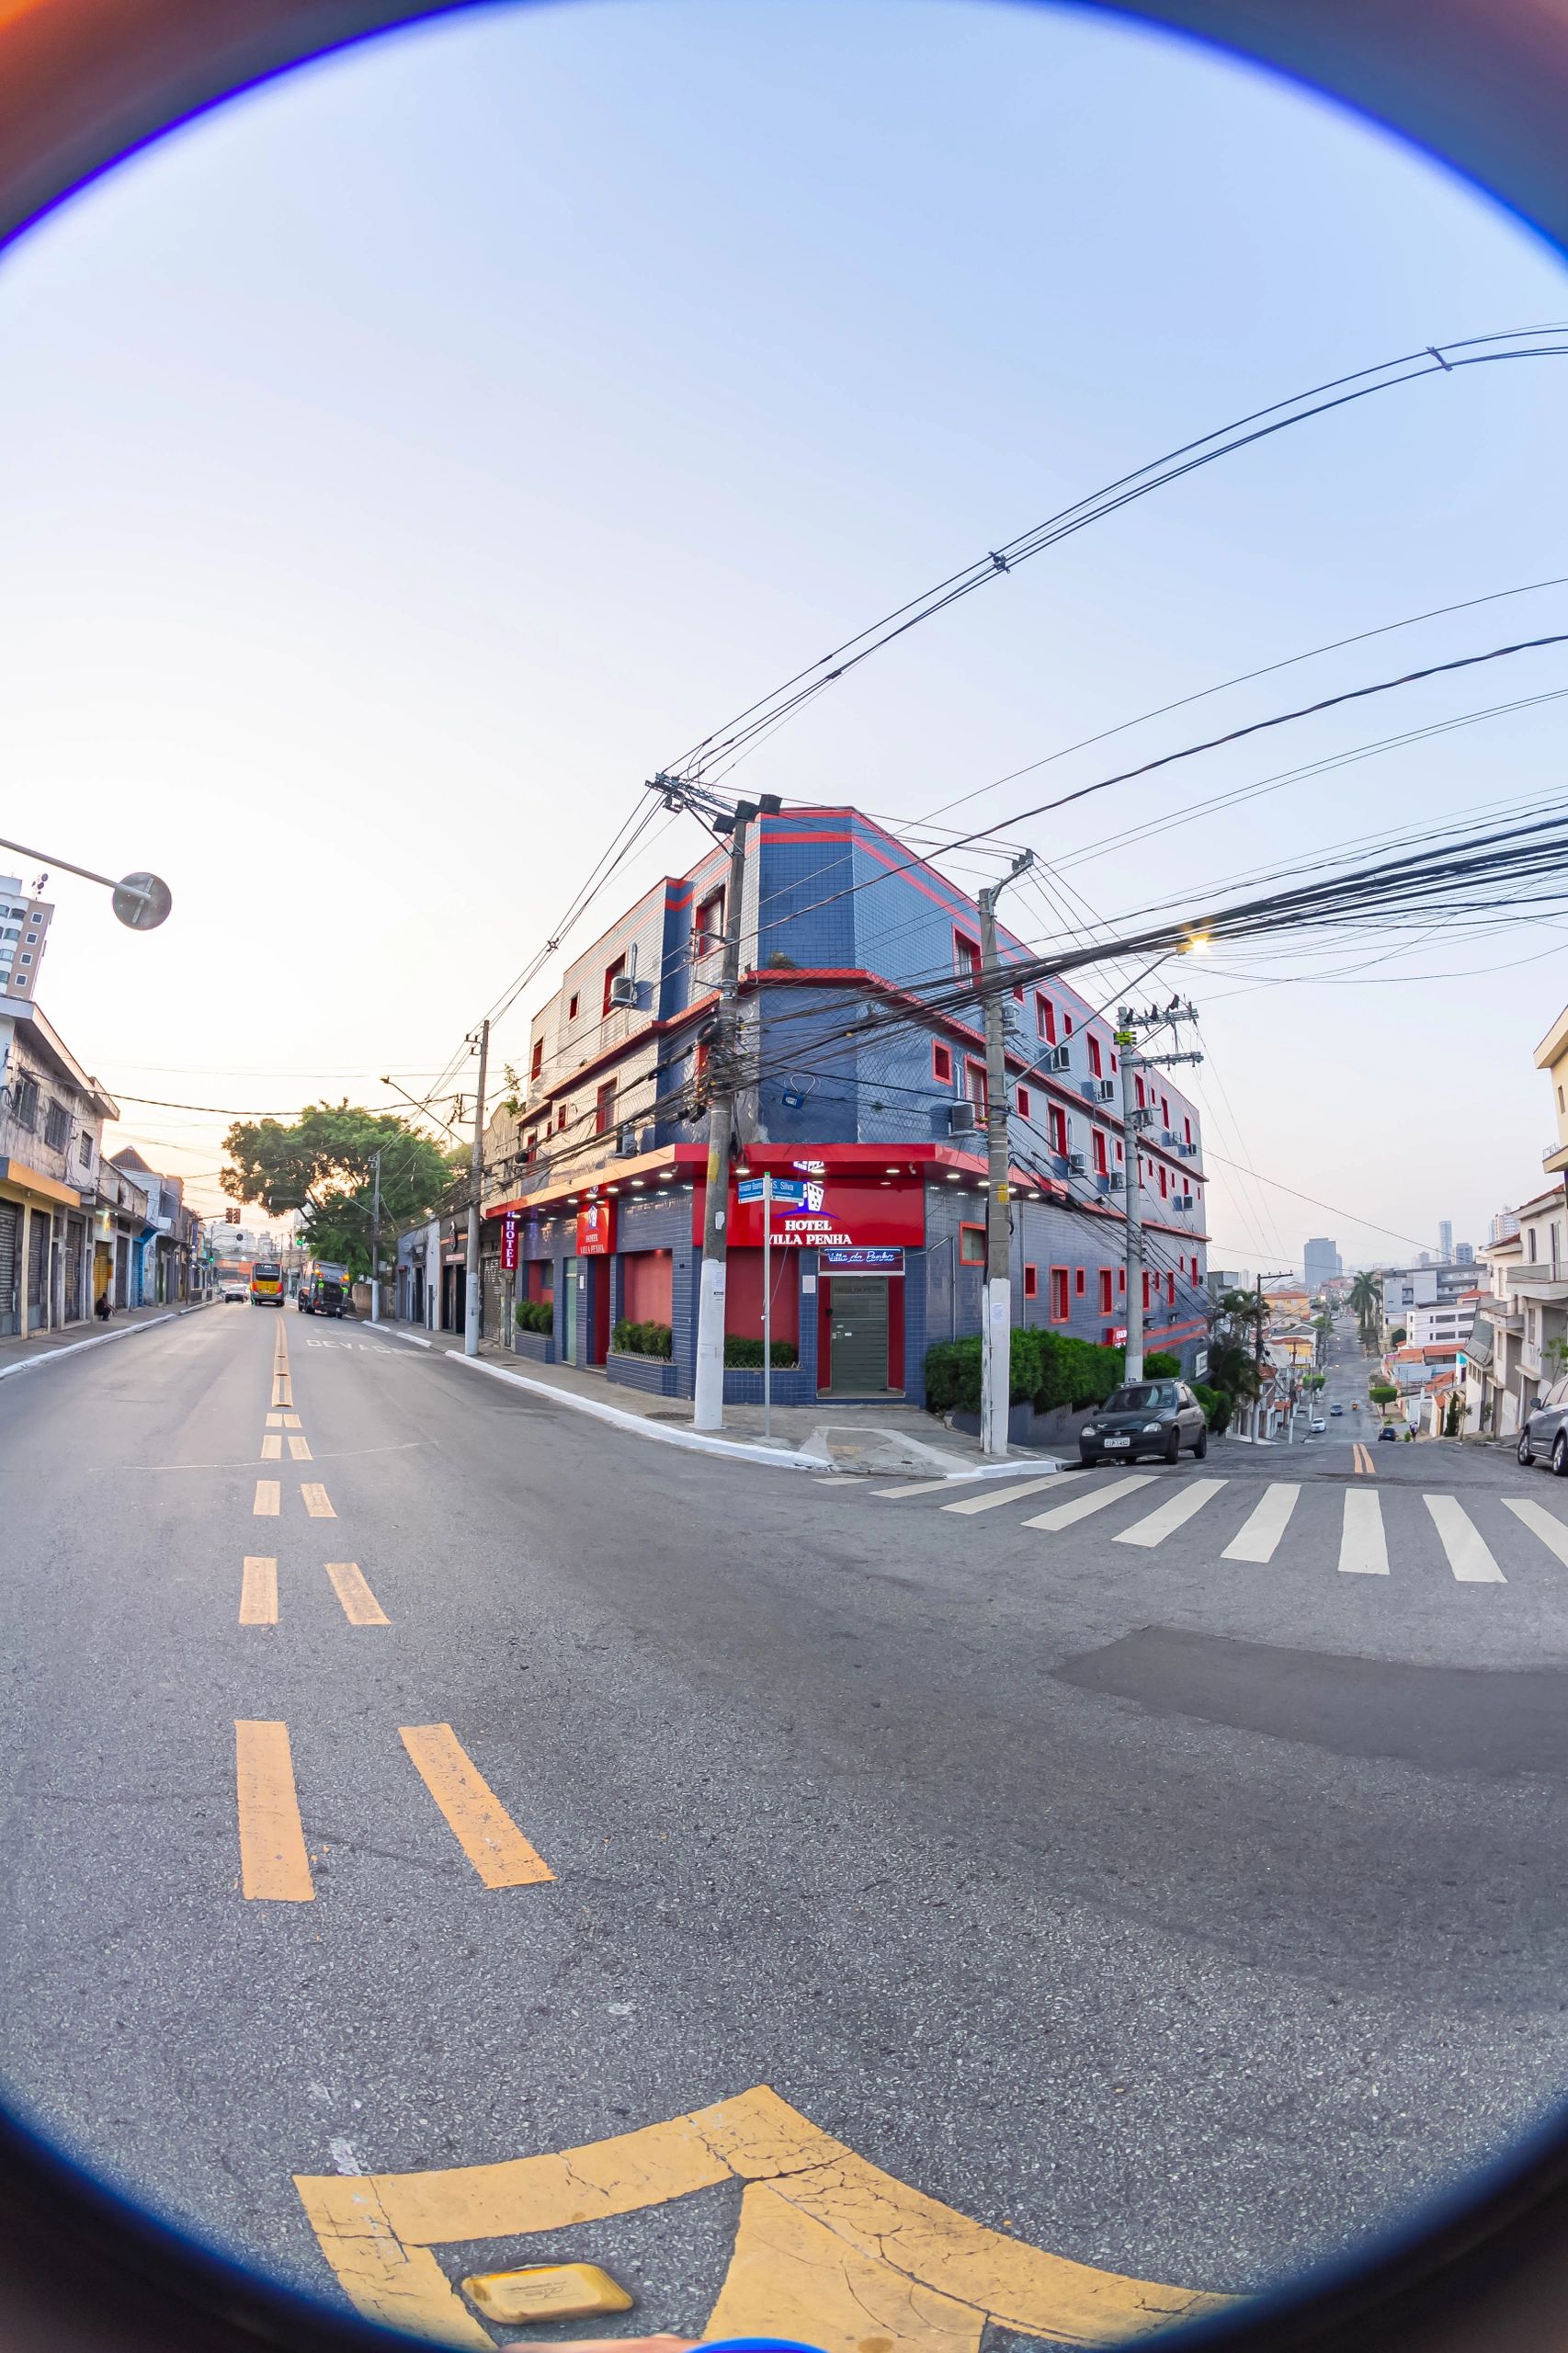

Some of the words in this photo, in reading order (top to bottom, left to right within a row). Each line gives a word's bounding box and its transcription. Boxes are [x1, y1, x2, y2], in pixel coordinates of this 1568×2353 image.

[779, 1181, 794, 1191] Silva
[784, 1220, 832, 1231] HOTEL
[506, 1221, 515, 1267] HOTEL
[805, 1233, 853, 1245] PENHA
